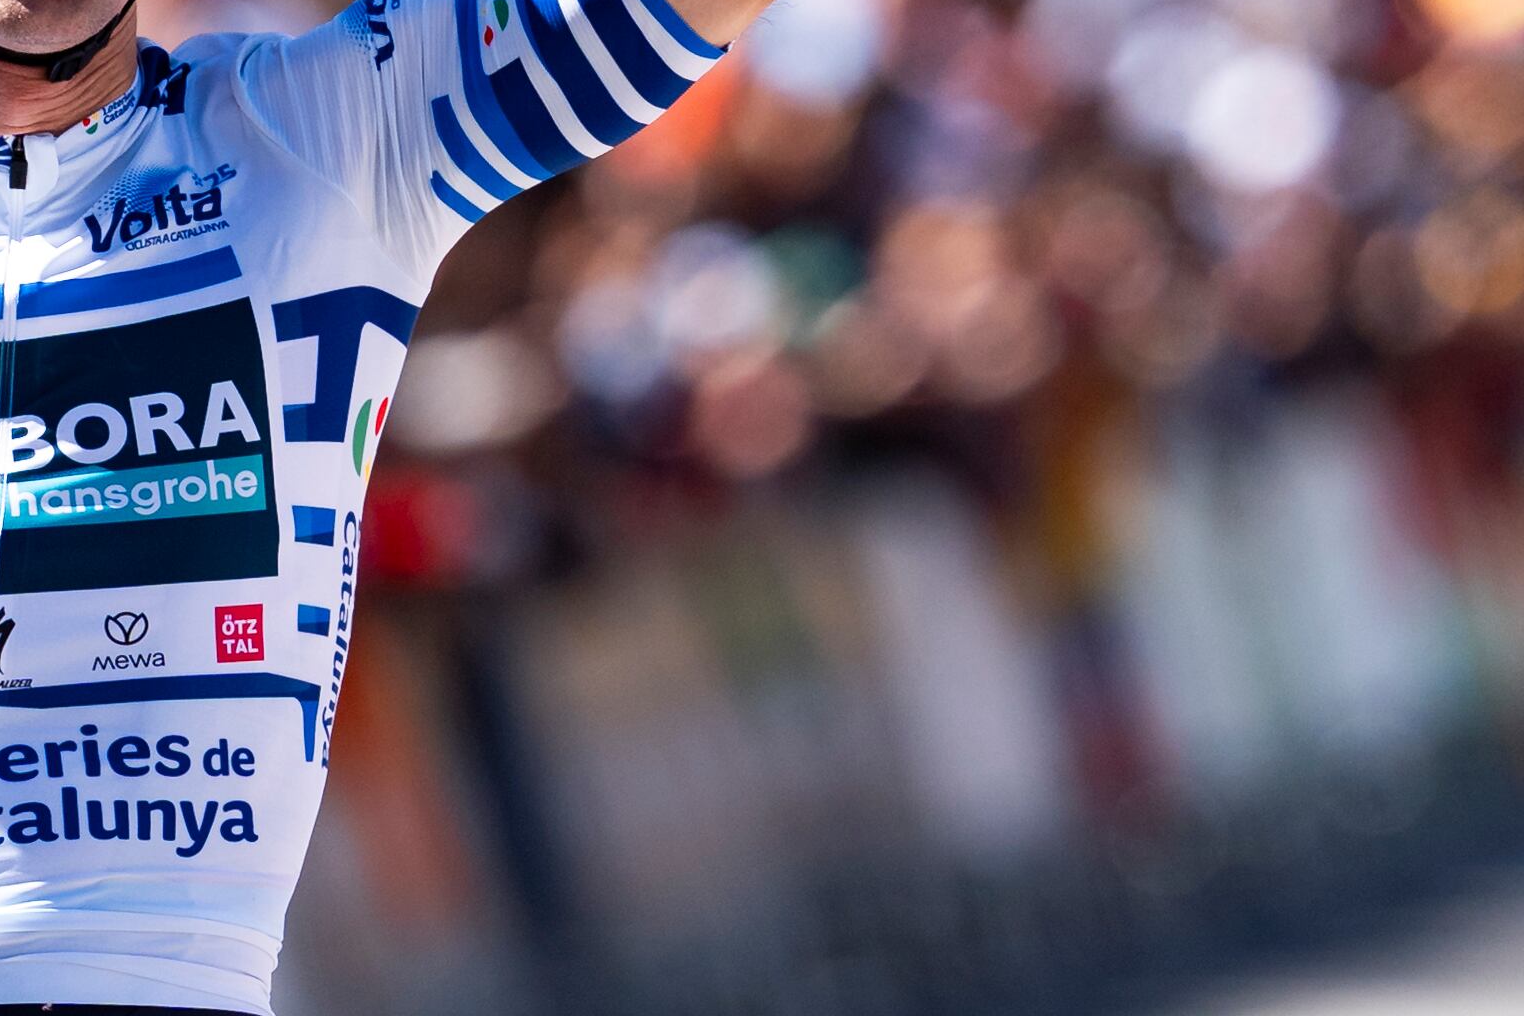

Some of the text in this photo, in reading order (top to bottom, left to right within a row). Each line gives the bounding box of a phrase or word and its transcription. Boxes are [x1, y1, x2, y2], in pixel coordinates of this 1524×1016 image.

[83, 184, 222, 253] Volta
[8, 460, 258, 517] hansgrohe
[221, 614, 258, 636] ÖTZ
[223, 639, 259, 655] TAL
[322, 510, 356, 769] Catalunya
[203, 738, 255, 777] de
